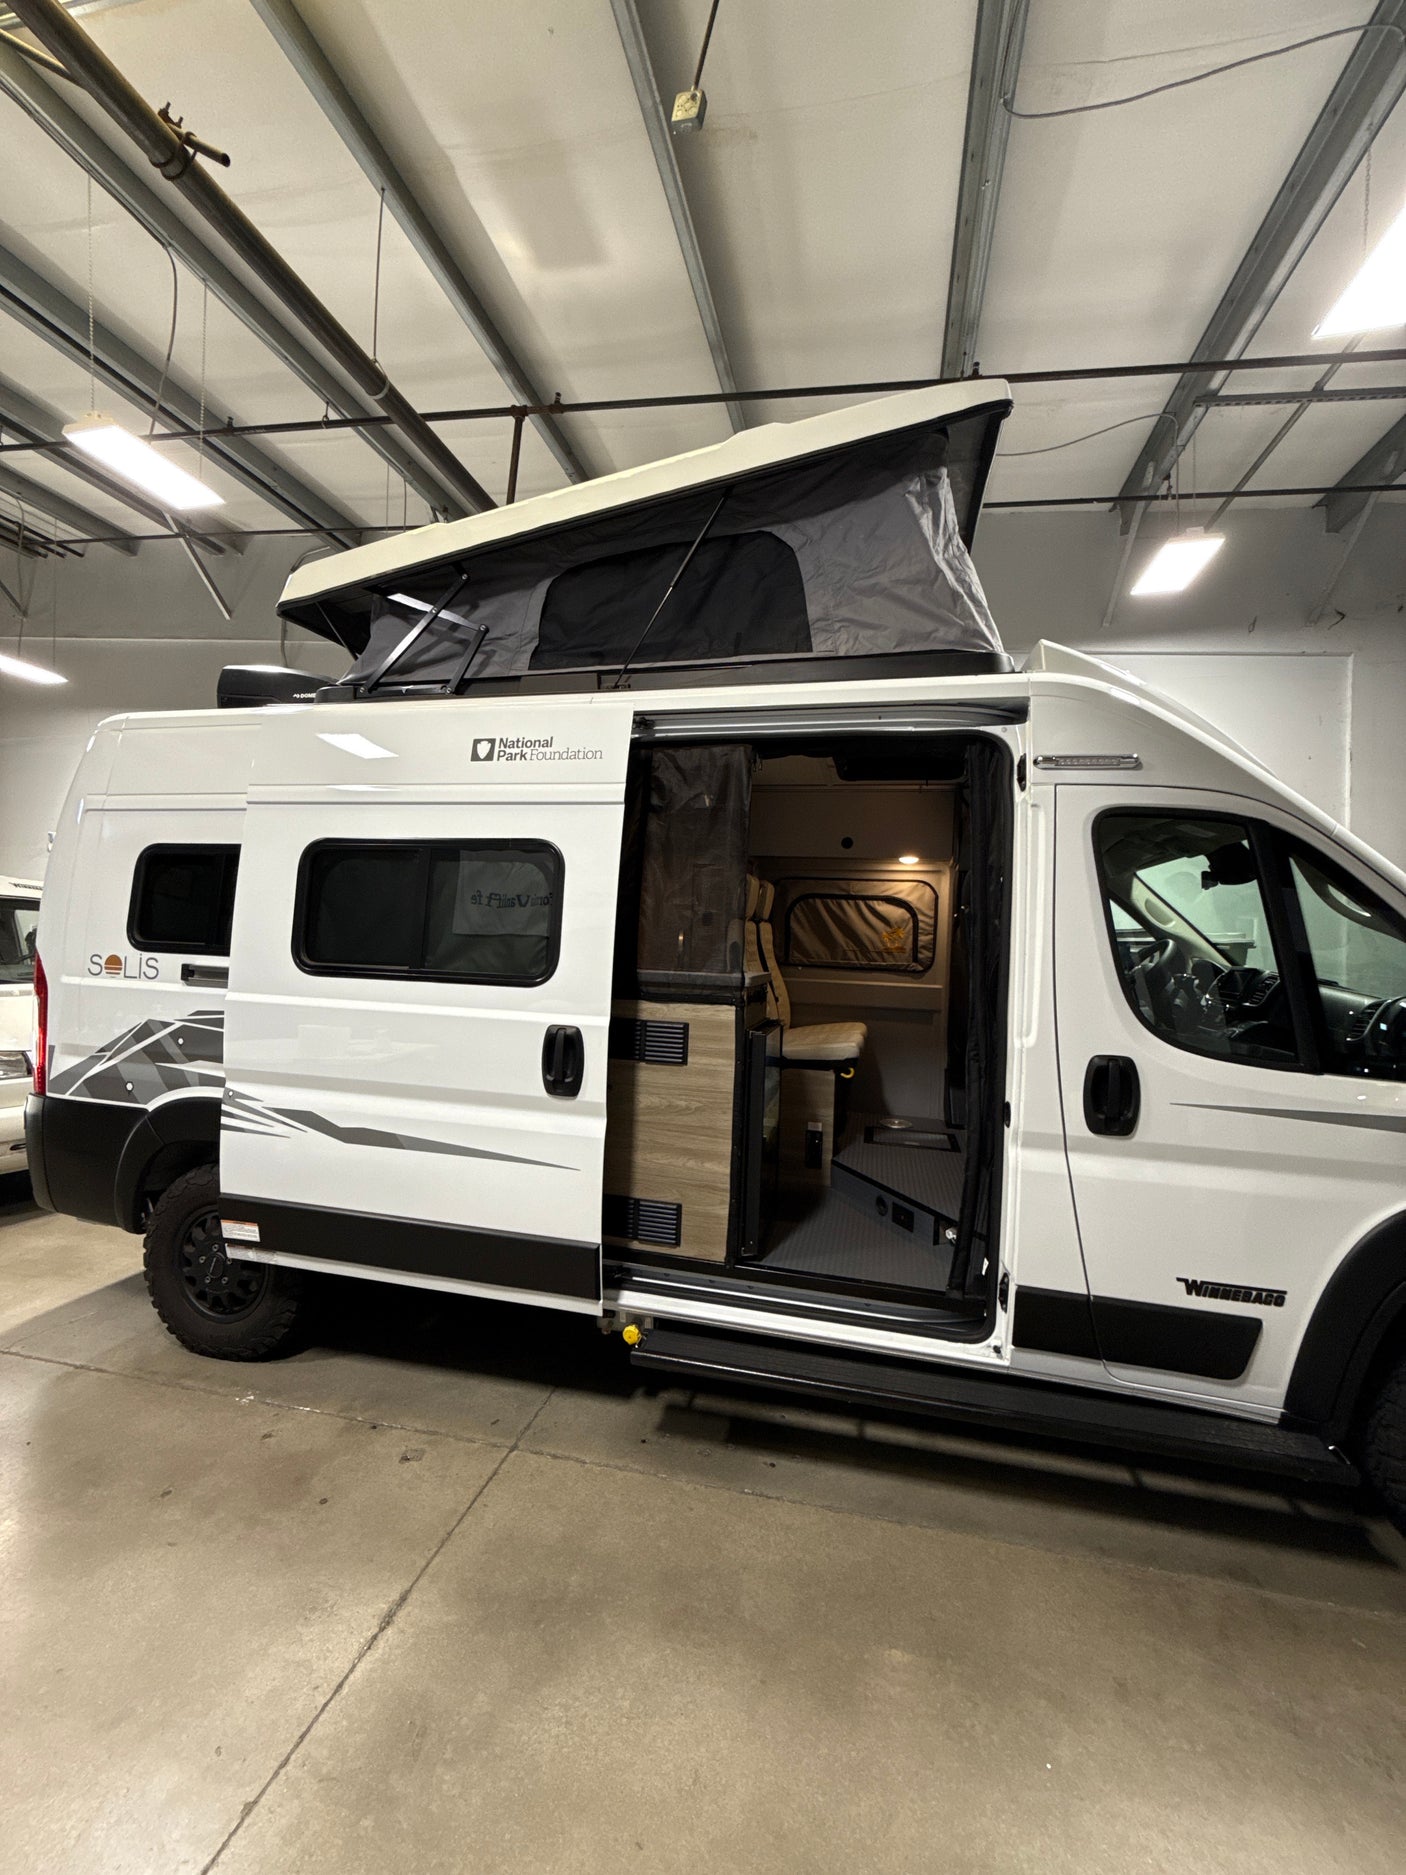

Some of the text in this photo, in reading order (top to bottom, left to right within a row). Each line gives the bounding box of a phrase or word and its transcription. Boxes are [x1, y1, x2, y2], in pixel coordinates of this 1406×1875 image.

[499, 736, 554, 749] National
[497, 747, 603, 762] Park Foundation
